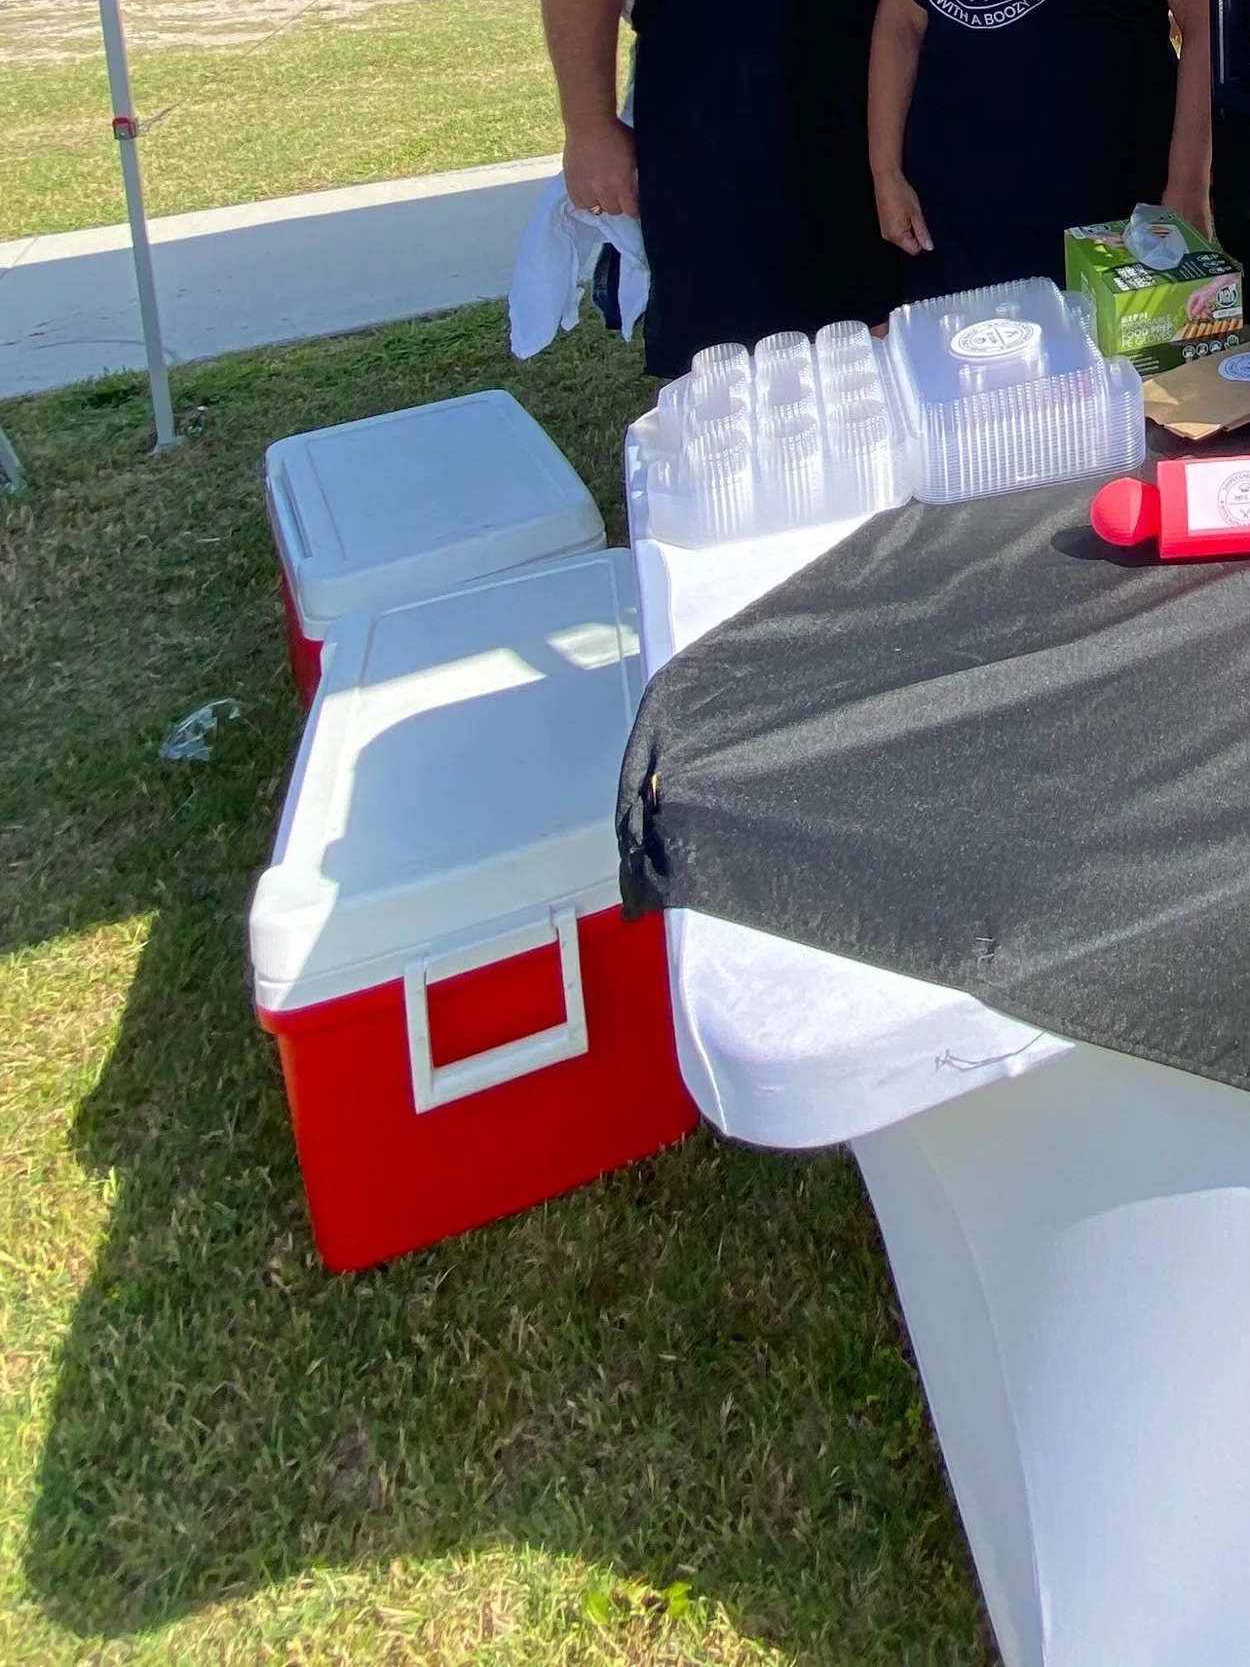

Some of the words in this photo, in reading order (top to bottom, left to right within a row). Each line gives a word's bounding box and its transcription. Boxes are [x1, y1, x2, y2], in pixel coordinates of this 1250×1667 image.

[971, 14, 982, 25] A
[984, 0, 1030, 26] BOOZY
[1122, 327, 1149, 339] FOOD
[1151, 322, 1172, 333] PREP
[1135, 332, 1172, 345] GLOVES
